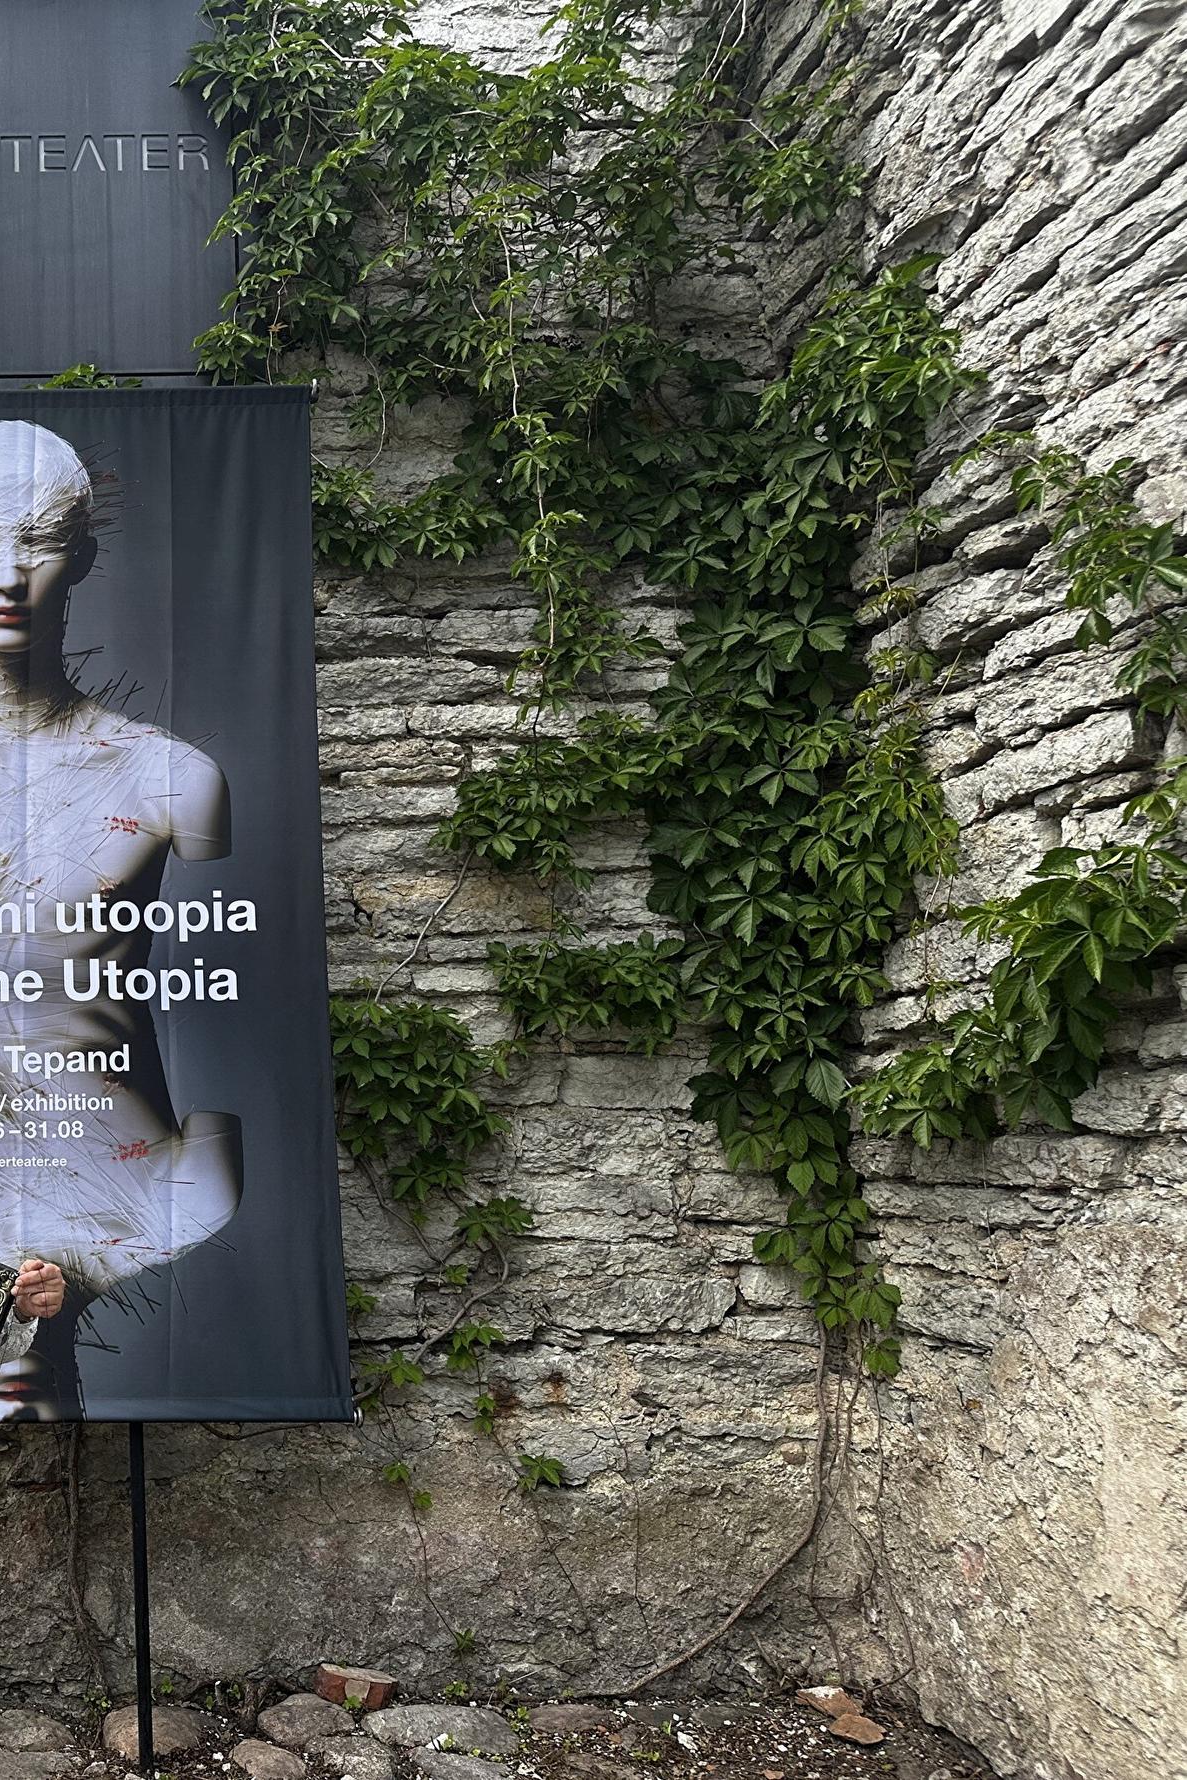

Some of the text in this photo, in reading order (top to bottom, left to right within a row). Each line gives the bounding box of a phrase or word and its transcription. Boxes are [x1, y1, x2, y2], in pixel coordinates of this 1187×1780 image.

[55, 889, 258, 943] utoopia
[63, 957, 239, 1011] Utopia
[4, 1044, 131, 1080] Tepand
[10, 1093, 114, 1112] exhibition
